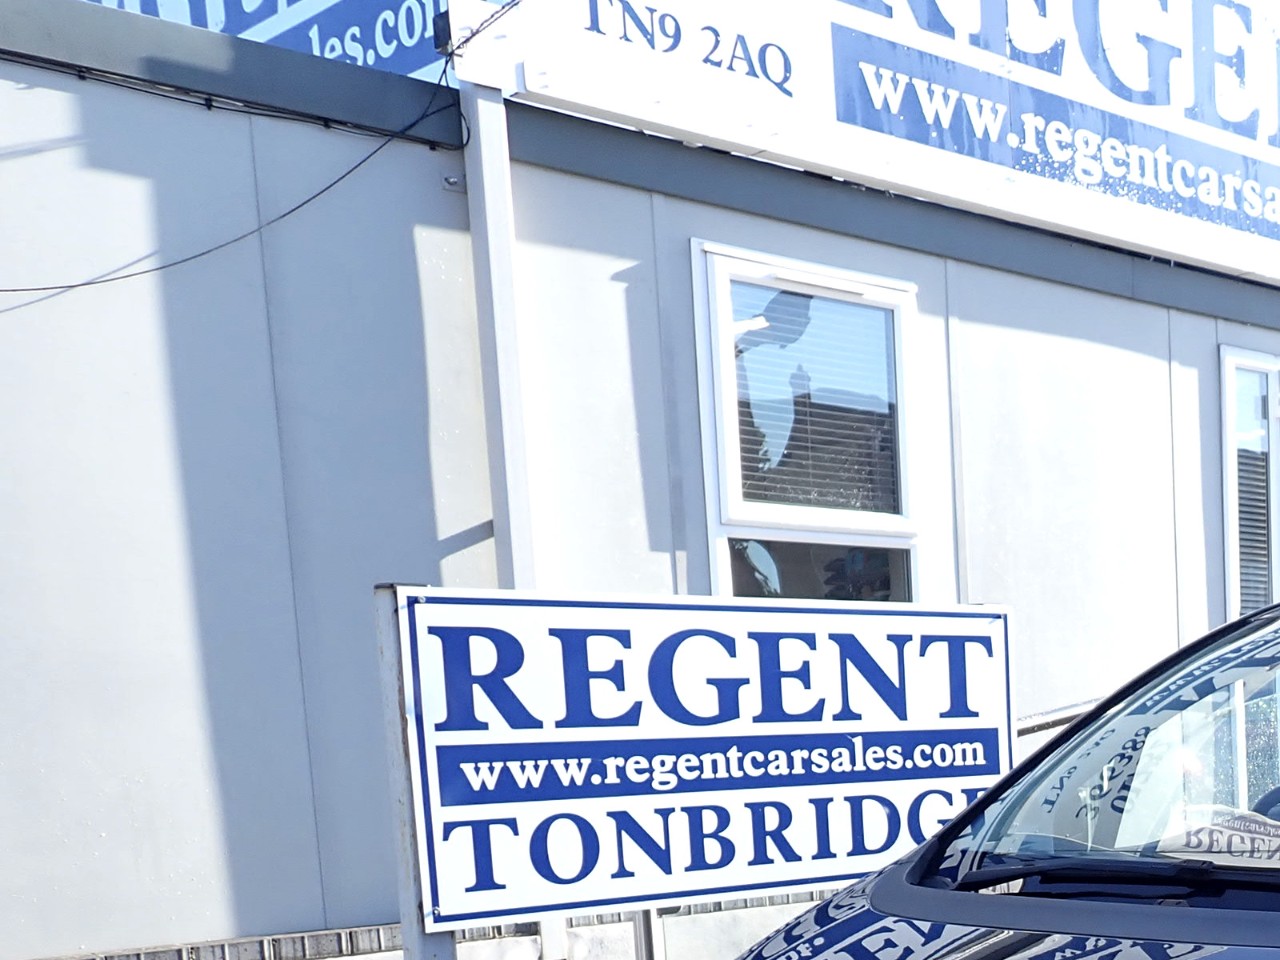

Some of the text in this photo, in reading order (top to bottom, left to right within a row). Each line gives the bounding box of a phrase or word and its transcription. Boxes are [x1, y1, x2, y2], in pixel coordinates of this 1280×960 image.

[700, 25, 793, 98] 2AQ
[427, 625, 994, 732] REGENT
[459, 735, 987, 793] www.regentcarsales.com
